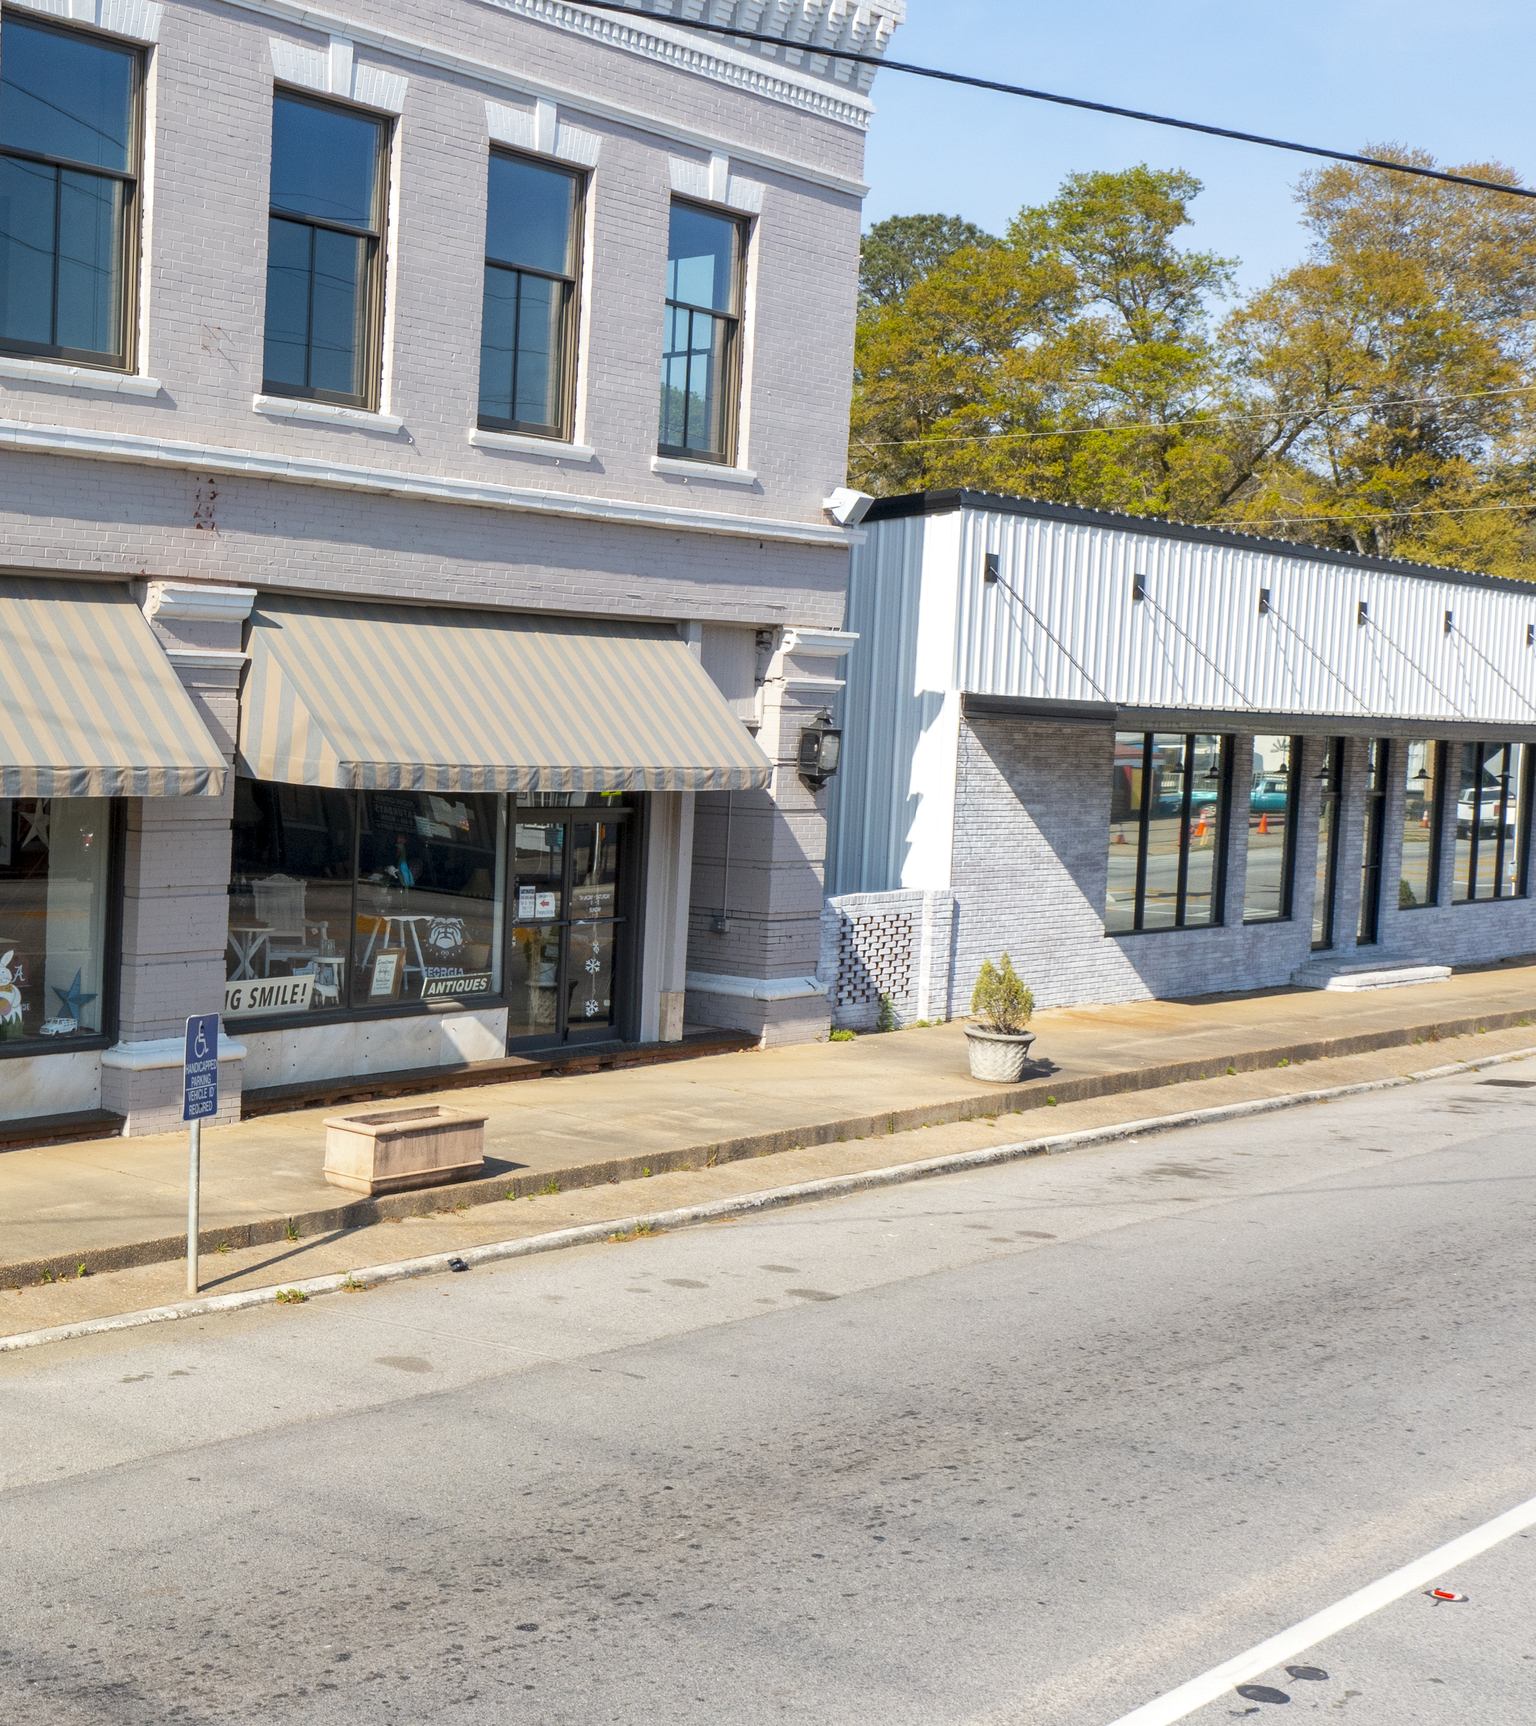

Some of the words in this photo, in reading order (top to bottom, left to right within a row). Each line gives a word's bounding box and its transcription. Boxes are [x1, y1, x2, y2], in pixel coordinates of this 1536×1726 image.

[427, 978, 488, 995] ANTIQUES
[247, 983, 307, 1009] SMILE!
[185, 1058, 217, 1075] HANDICAPPED
[191, 1073, 212, 1088] PARKING
[187, 1088, 208, 1102] VEHICLE
[208, 1087, 215, 1098] ID
[189, 1101, 213, 1116] REQUIRED
